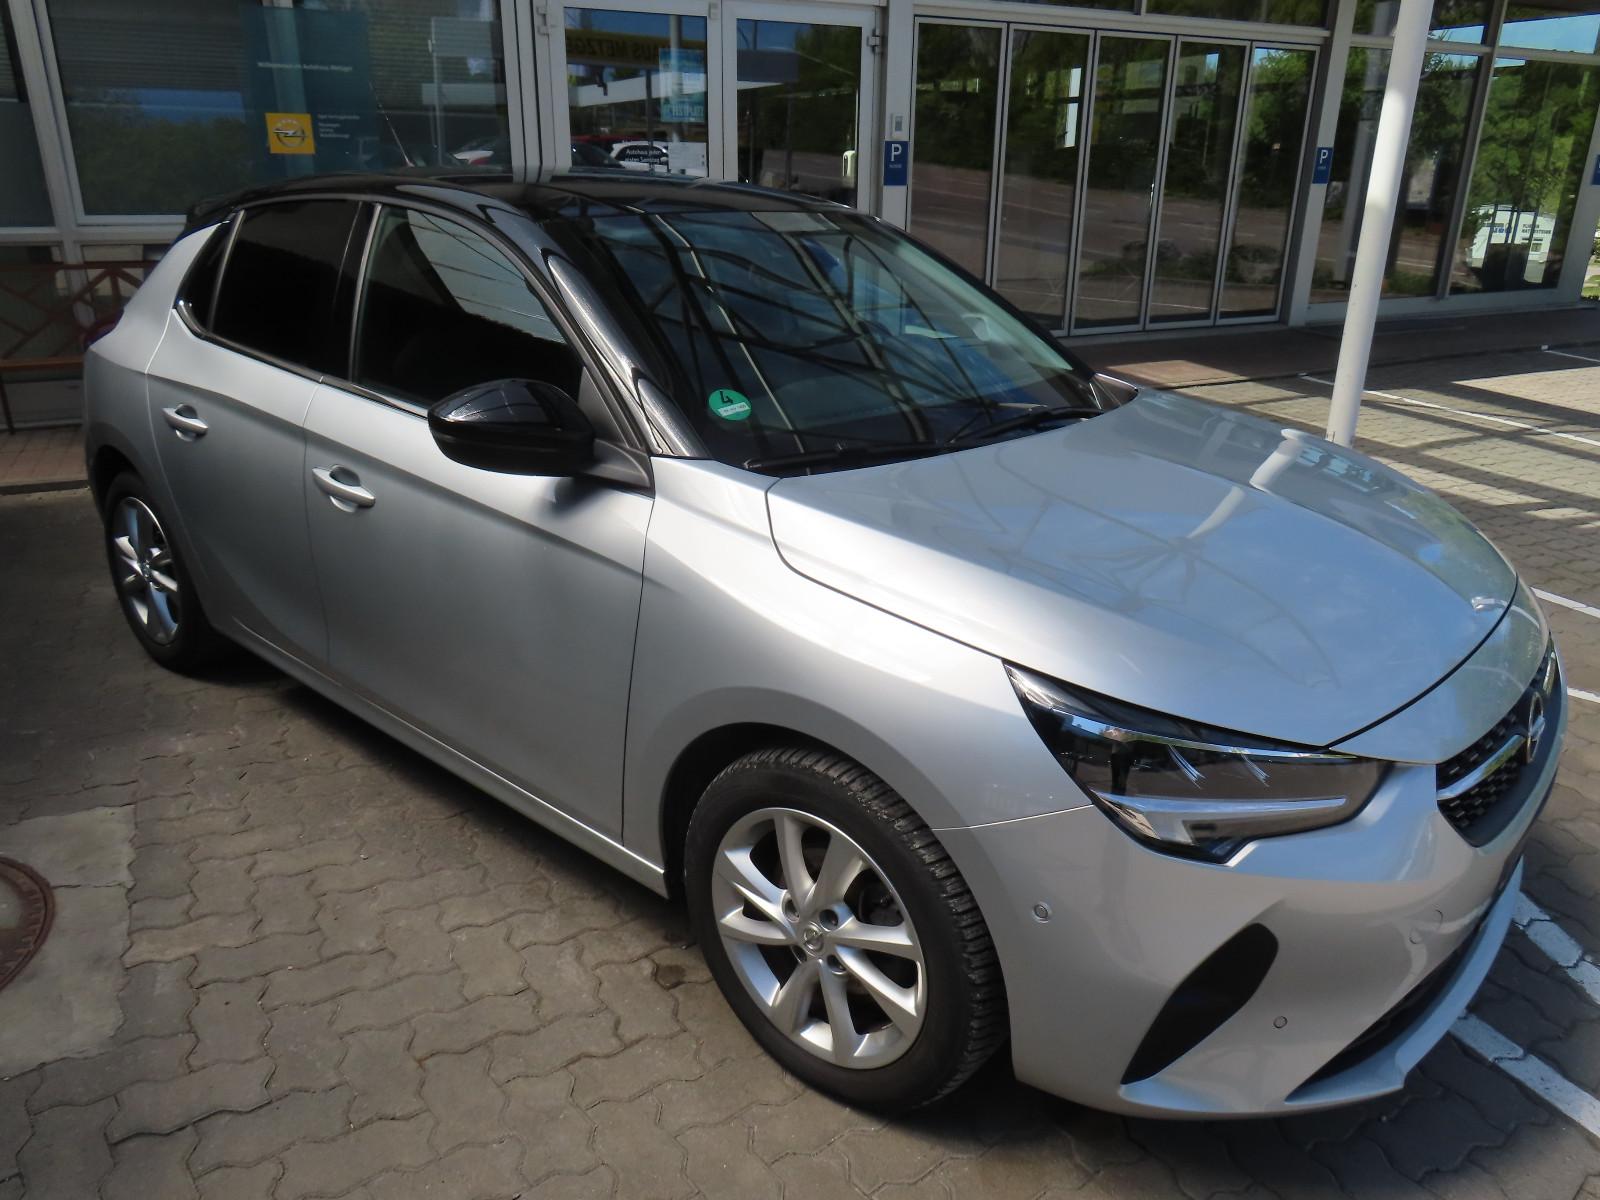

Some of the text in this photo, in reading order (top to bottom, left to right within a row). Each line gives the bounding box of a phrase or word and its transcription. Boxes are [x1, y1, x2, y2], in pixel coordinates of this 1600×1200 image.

[890, 143, 902, 162] P
[1319, 149, 1329, 164] P
[720, 390, 734, 404] 4
